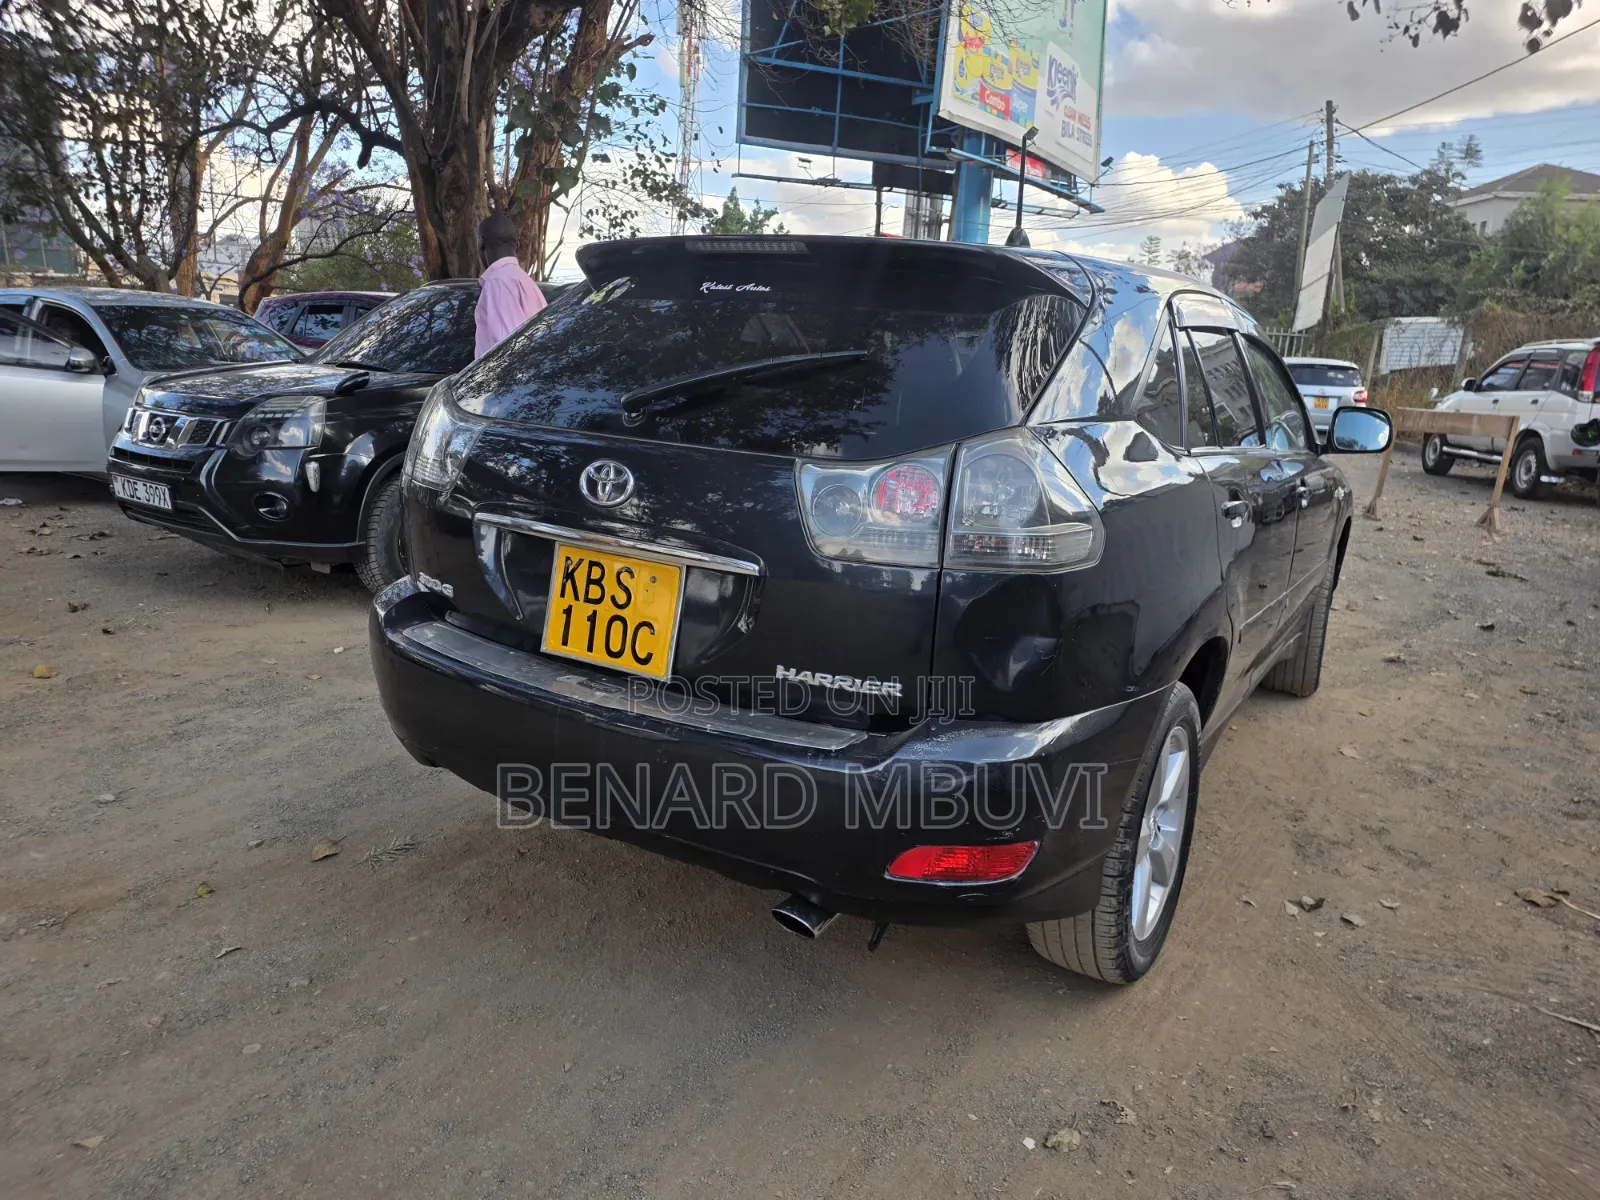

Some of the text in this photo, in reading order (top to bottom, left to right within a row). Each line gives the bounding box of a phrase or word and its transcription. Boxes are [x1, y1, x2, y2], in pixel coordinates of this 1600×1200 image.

[984, 90, 1006, 112] Combo
[1061, 119, 1075, 140] BILA
[120, 477, 170, 508] KDE 399X
[559, 555, 636, 611] KBS
[560, 603, 656, 667] 110C
[775, 664, 903, 698] HARRIER
